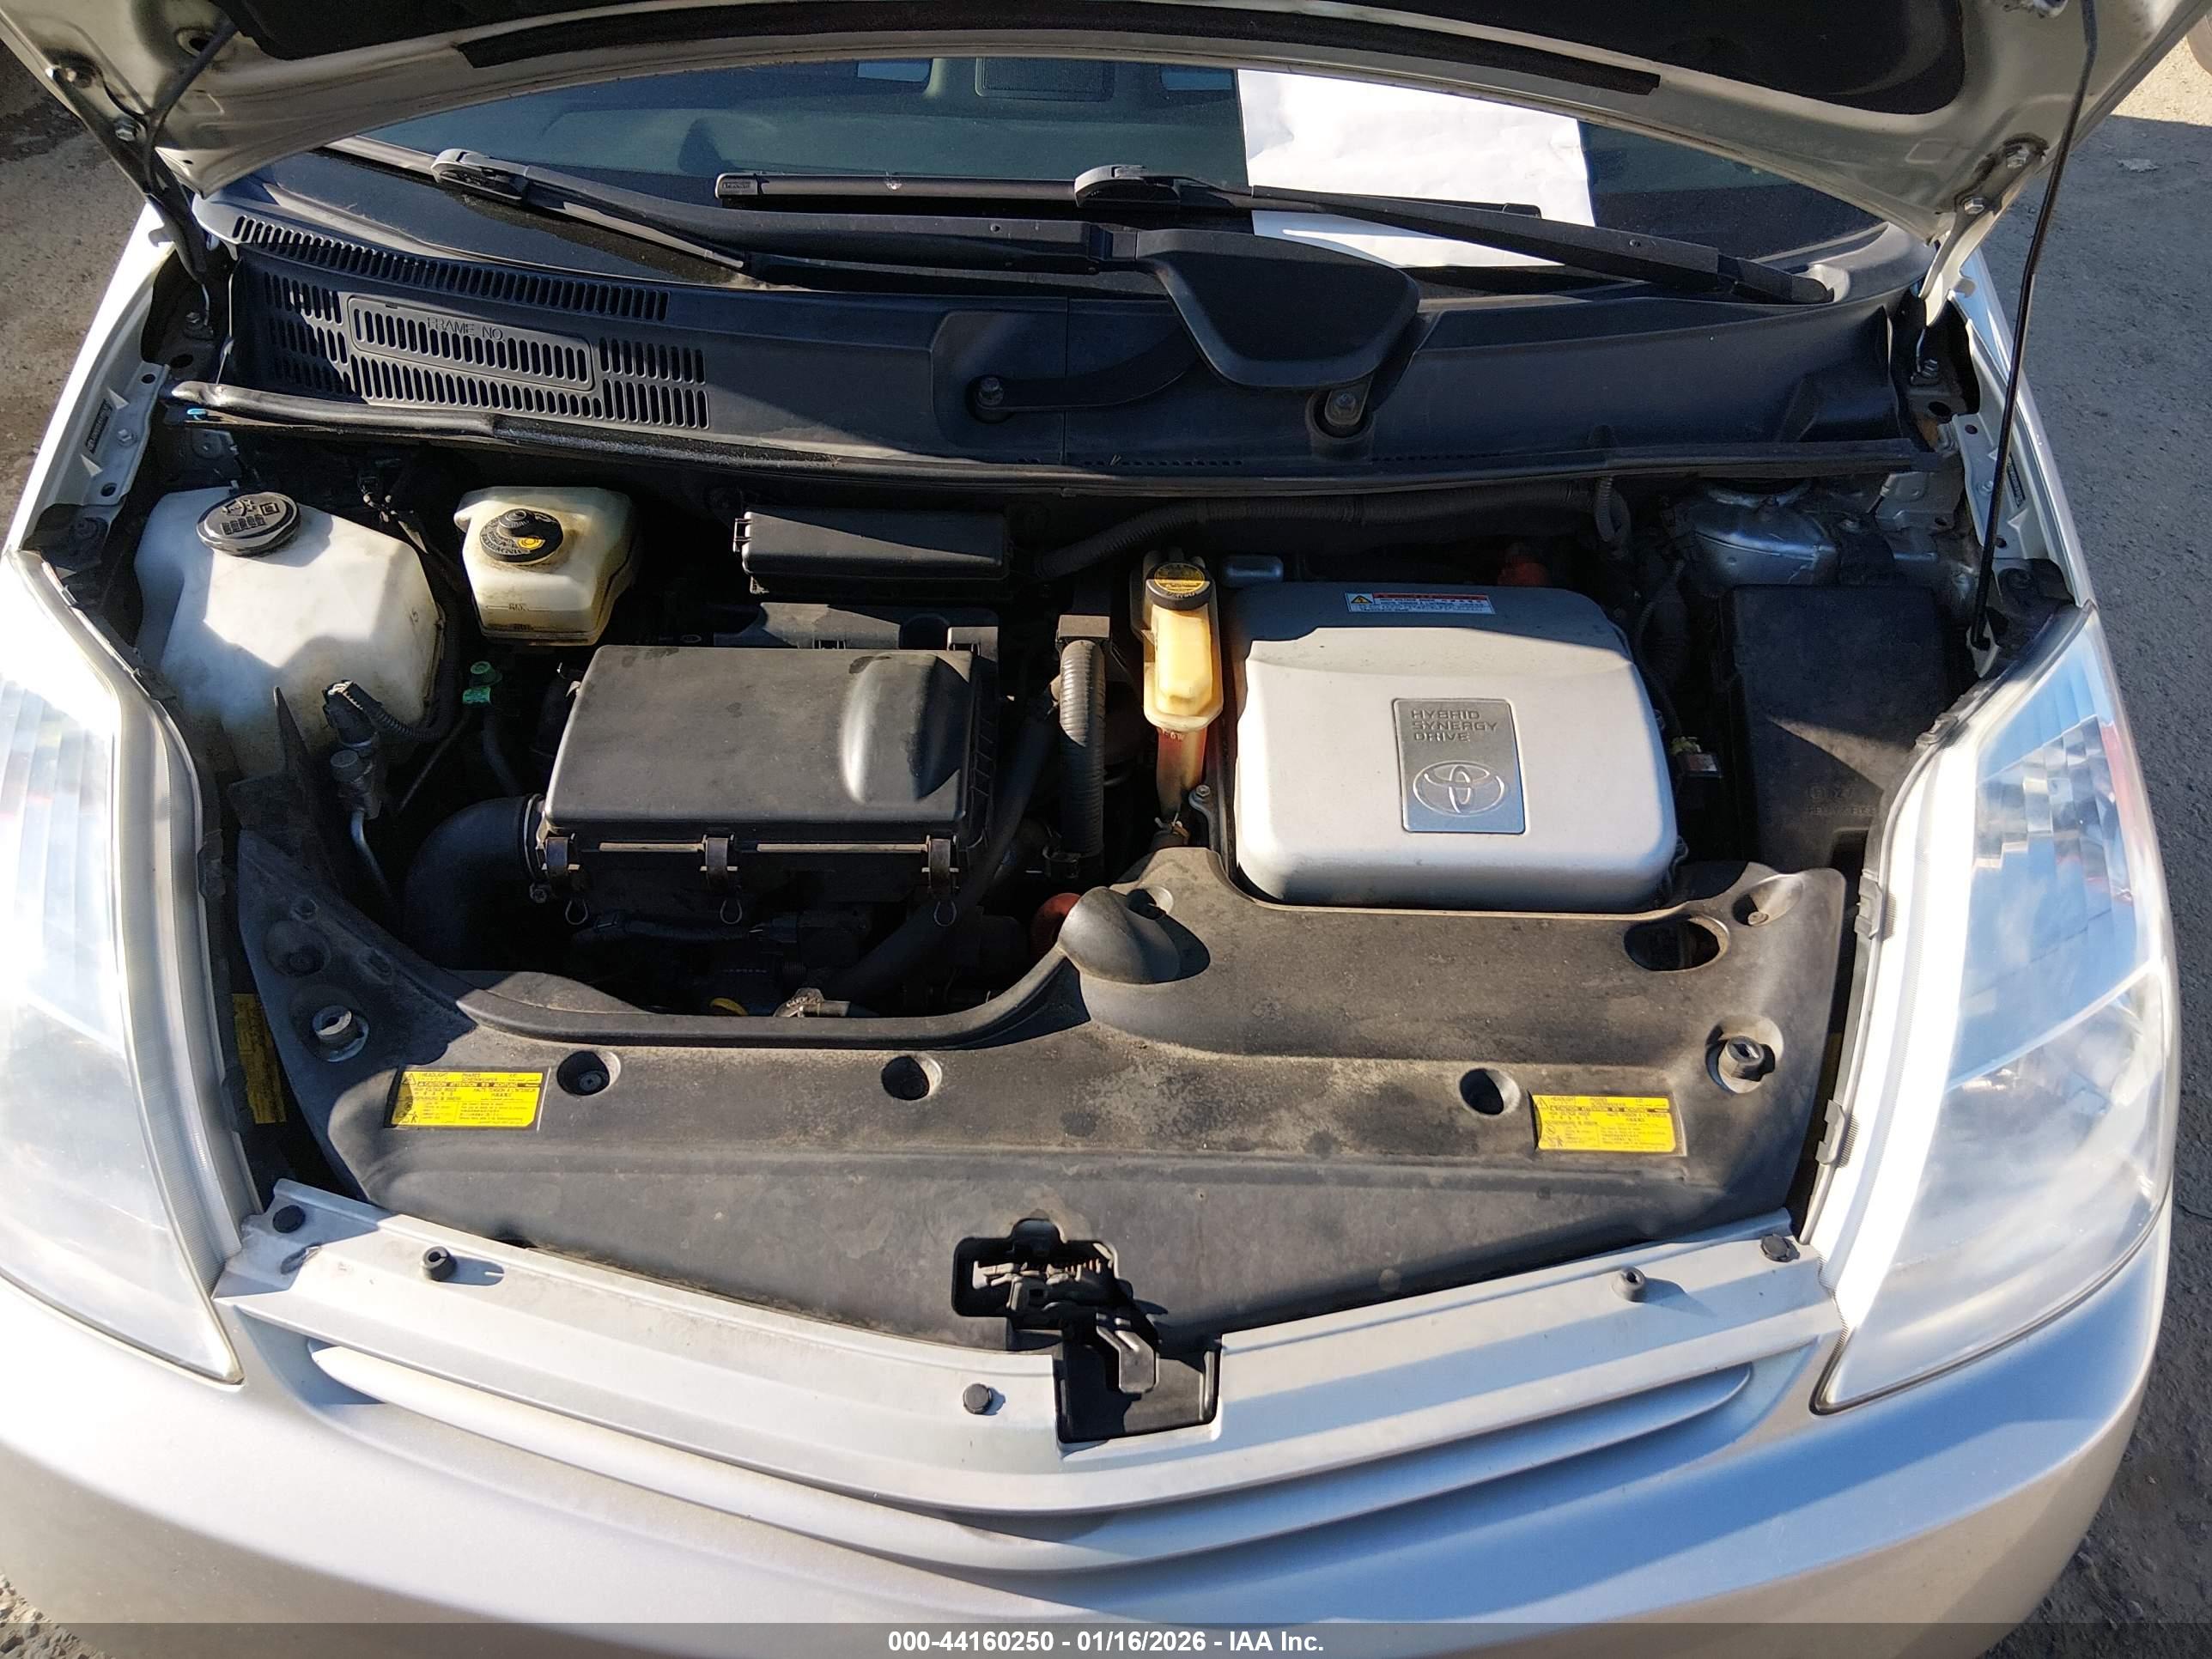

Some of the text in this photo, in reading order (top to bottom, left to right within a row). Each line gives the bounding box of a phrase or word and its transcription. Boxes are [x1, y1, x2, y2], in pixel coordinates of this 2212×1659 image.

[427, 317, 475, 337] FRAME
[1411, 709, 1480, 720] HYBRID
[1412, 720, 1498, 732] SYNERGY
[1414, 731, 1471, 742] DRIVE
